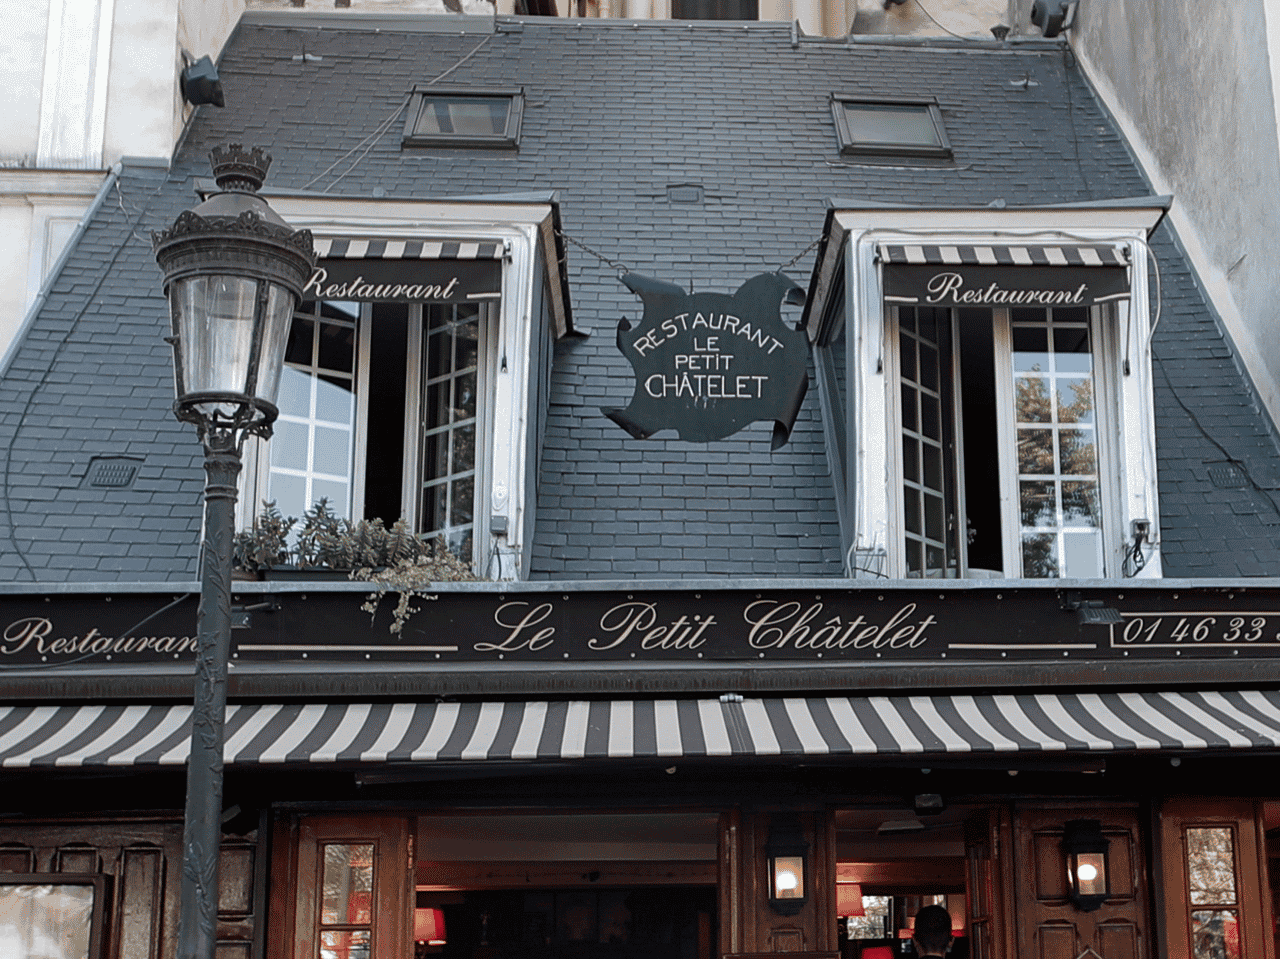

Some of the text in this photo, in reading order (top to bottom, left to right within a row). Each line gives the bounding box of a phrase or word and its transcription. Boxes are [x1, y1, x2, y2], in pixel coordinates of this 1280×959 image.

[303, 266, 460, 299] Restaurant
[926, 272, 1089, 304] Restaurant
[633, 312, 784, 357] RESTAURANT
[694, 337, 720, 351] LE
[675, 354, 734, 370] PETIT
[645, 372, 769, 399] CHÂTELET
[0, 617, 201, 654] Restauran
[473, 601, 556, 651] Le
[588, 601, 717, 651] Petit
[743, 599, 938, 650] Châtelet
[1122, 617, 1163, 642] 01
[1170, 617, 1216, 641] 46
[1223, 617, 1266, 641] 33
